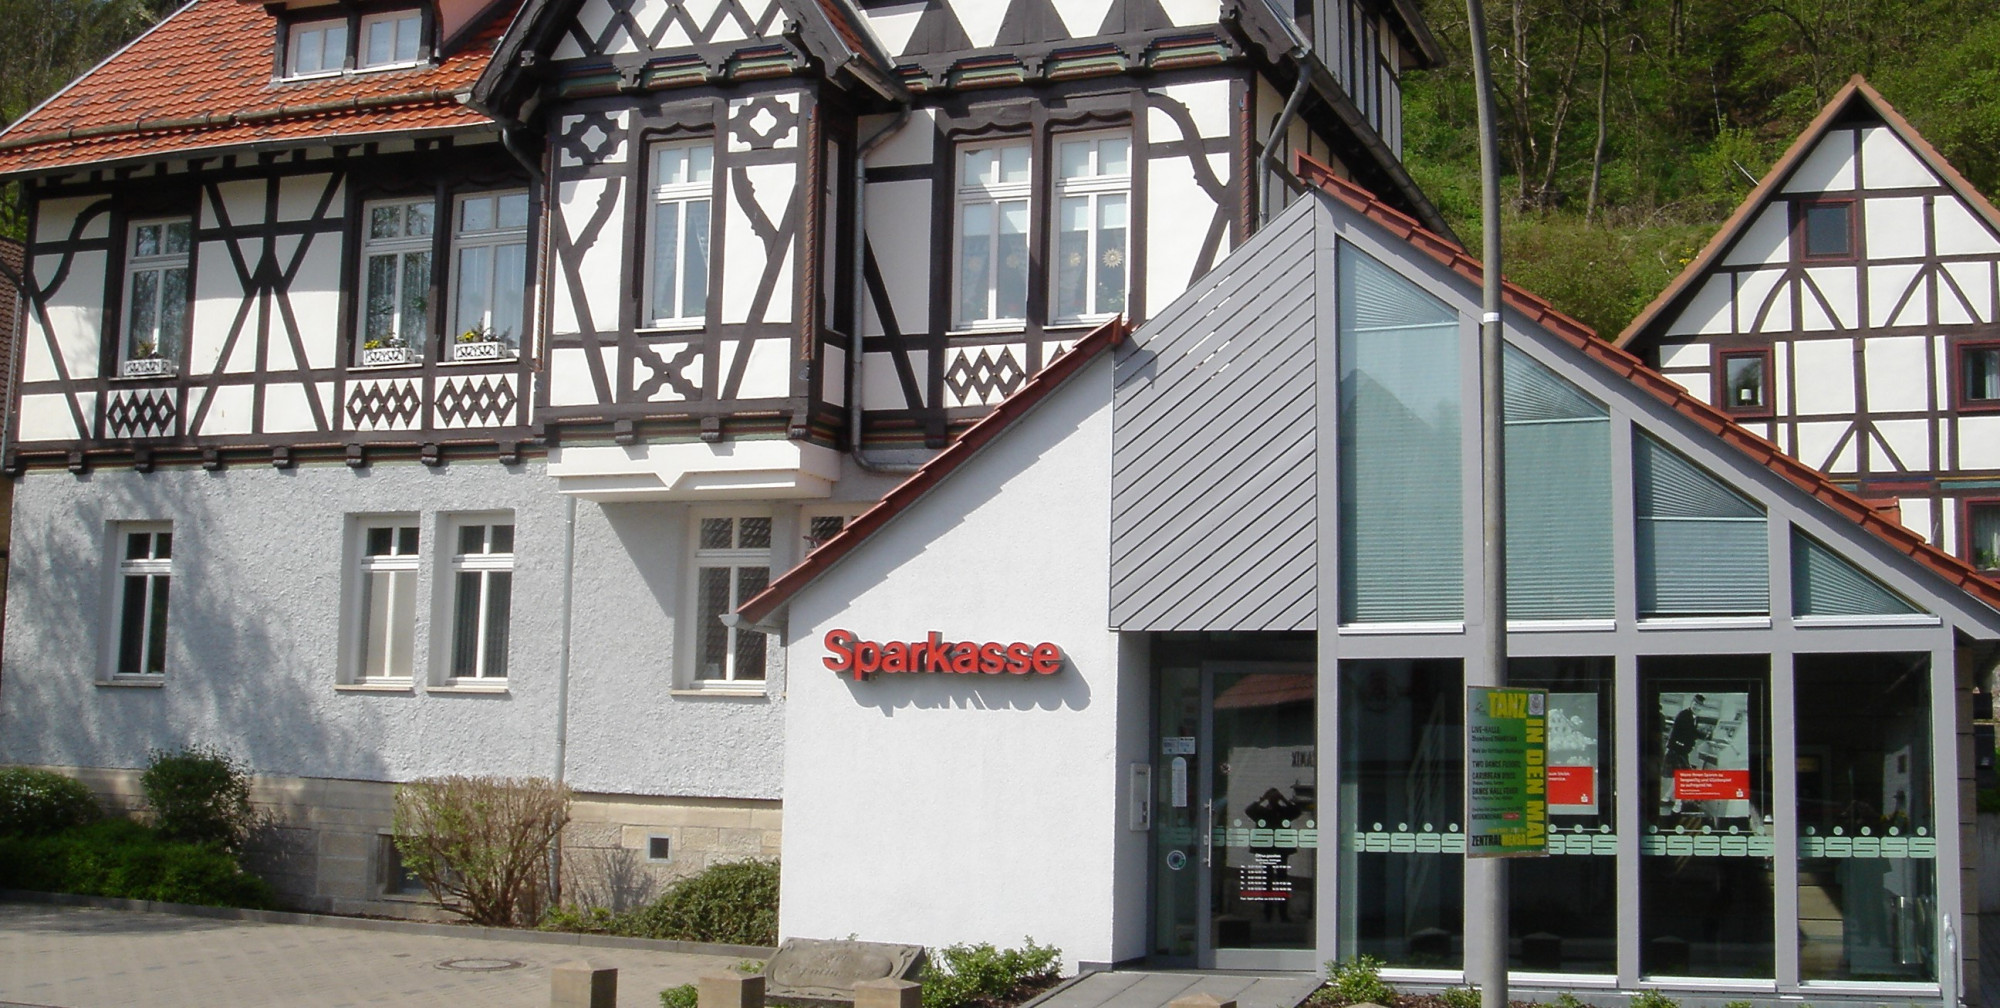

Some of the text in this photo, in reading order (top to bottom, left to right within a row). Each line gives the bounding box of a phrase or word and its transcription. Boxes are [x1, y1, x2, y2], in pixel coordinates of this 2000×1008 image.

[822, 629, 1061, 681] Sparkasse
[1488, 692, 1527, 718] TANZ
[1526, 719, 1545, 846] IN DEN MAI
